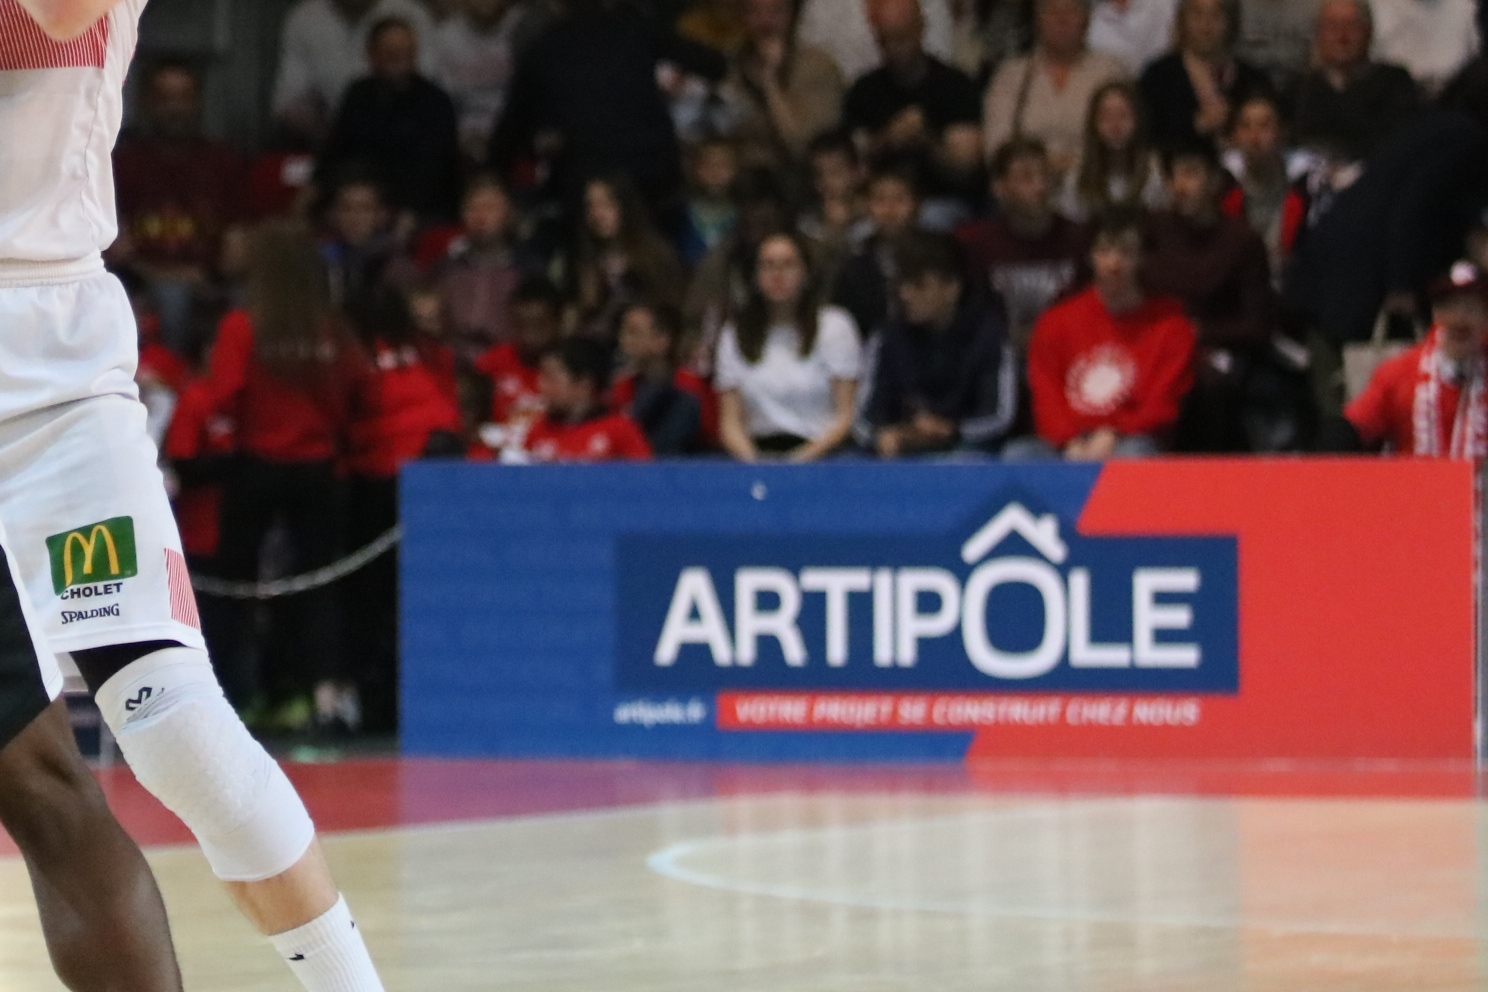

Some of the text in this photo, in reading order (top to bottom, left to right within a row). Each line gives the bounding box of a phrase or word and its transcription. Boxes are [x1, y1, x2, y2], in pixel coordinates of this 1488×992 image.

[61, 582, 123, 601] CHOLET
[61, 603, 120, 625] SPALDING
[813, 695, 894, 726] PROJET
[898, 696, 926, 724] SE
[1065, 696, 1129, 725] CHEZ
[1132, 696, 1199, 725] NOUS
